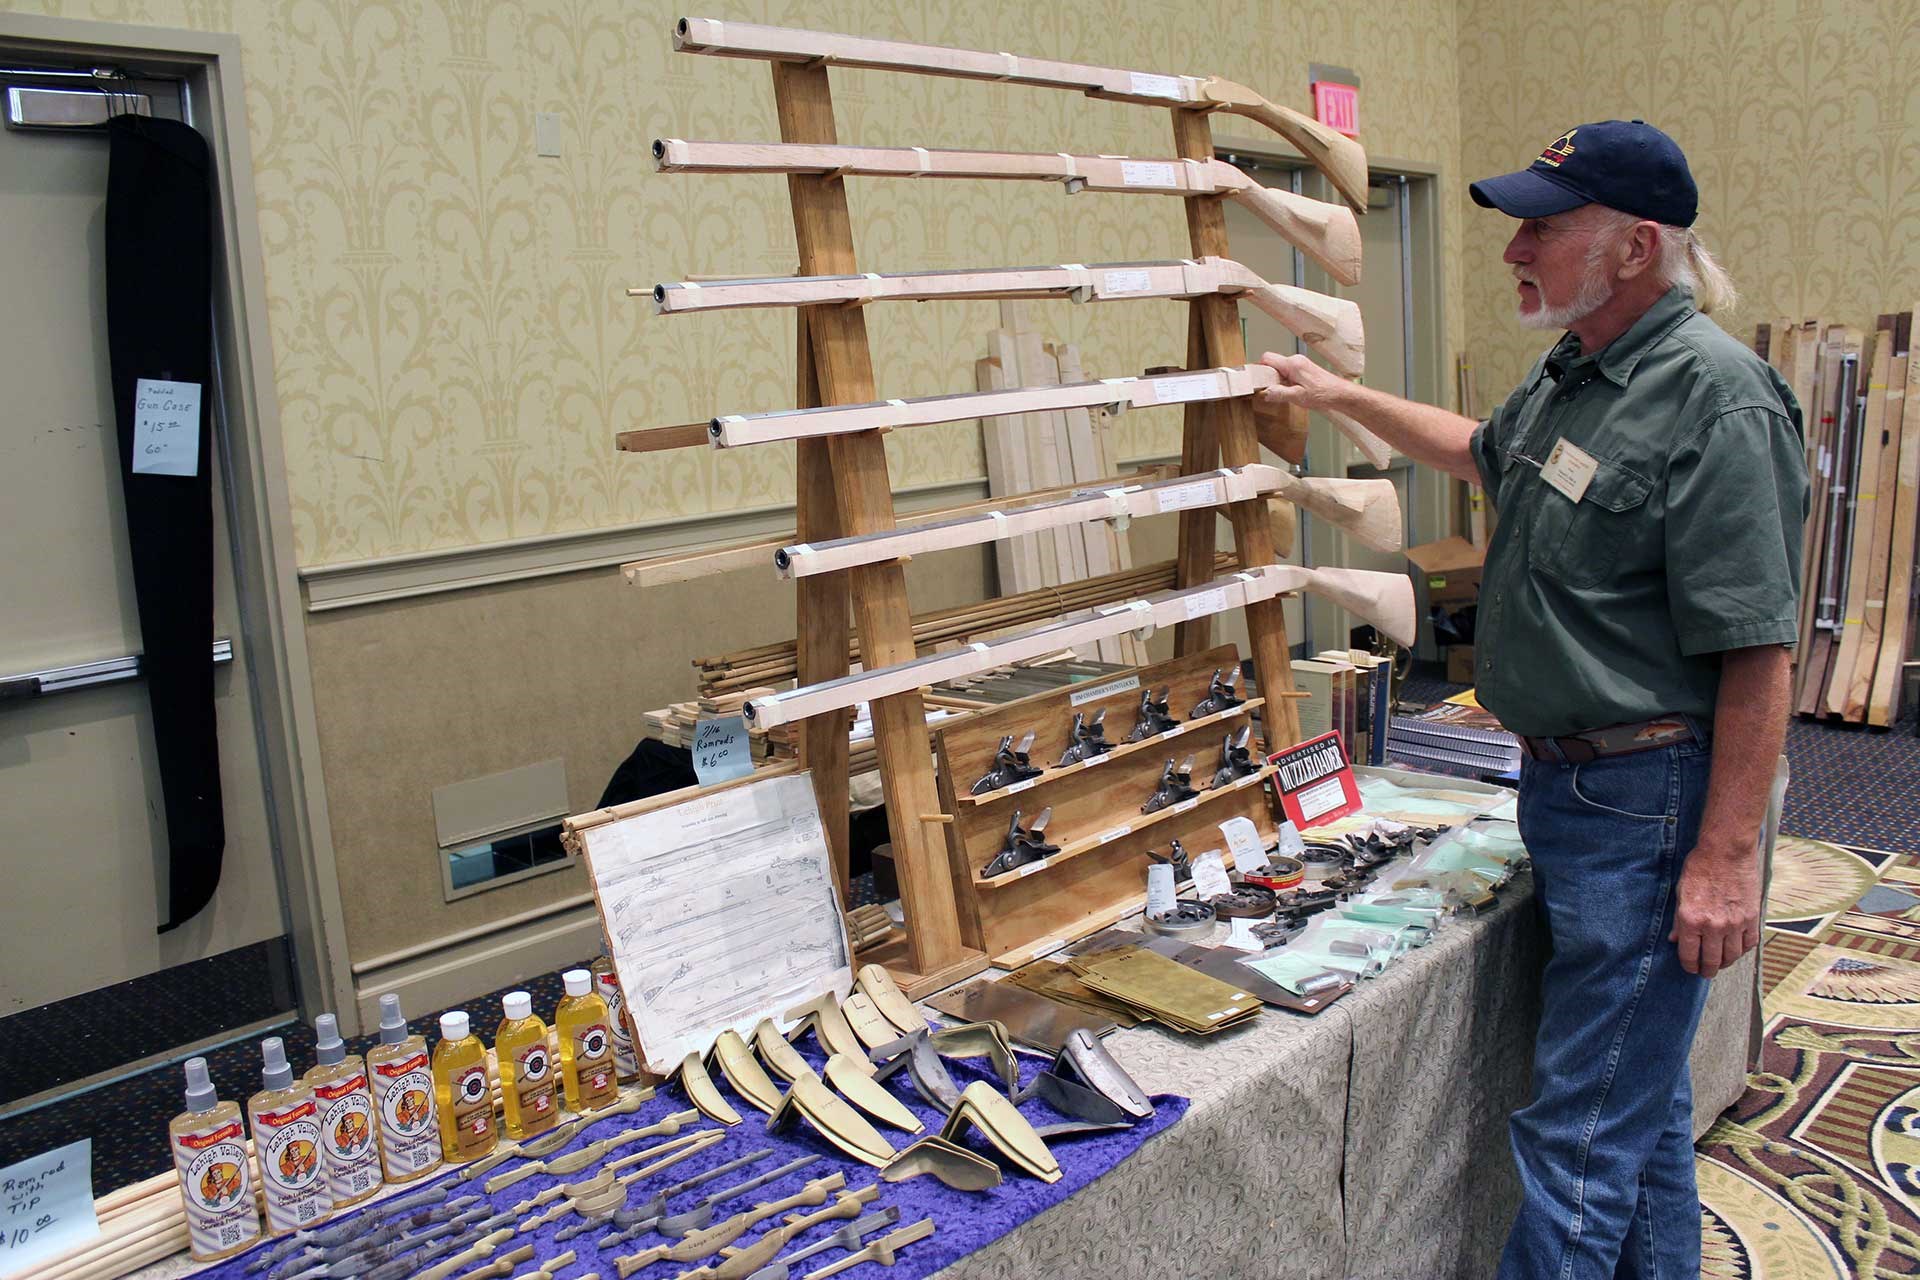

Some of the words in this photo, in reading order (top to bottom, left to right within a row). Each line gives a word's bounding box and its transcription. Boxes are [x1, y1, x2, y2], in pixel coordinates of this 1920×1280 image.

[1325, 87, 1355, 130] EXIT
[137, 398, 159, 410] Gun
[696, 734, 735, 752] Ramrods
[1276, 742, 1325, 766] ADVERTISED
[1327, 738, 1337, 746] IN
[1278, 745, 1345, 792] MUZZLELOADER
[389, 1066, 406, 1076] Original
[328, 1088, 347, 1098] Original
[387, 1077, 411, 1103] Lehigh
[412, 1074, 432, 1090] Valley
[272, 1115, 291, 1125] Original
[325, 1100, 350, 1126] Lehigh
[351, 1096, 370, 1111] Valley
[193, 1134, 214, 1147] Original
[269, 1127, 295, 1154] Lehigh
[297, 1123, 319, 1139] Valley
[190, 1149, 217, 1177] Lehigh
[219, 1145, 244, 1161] Valley
